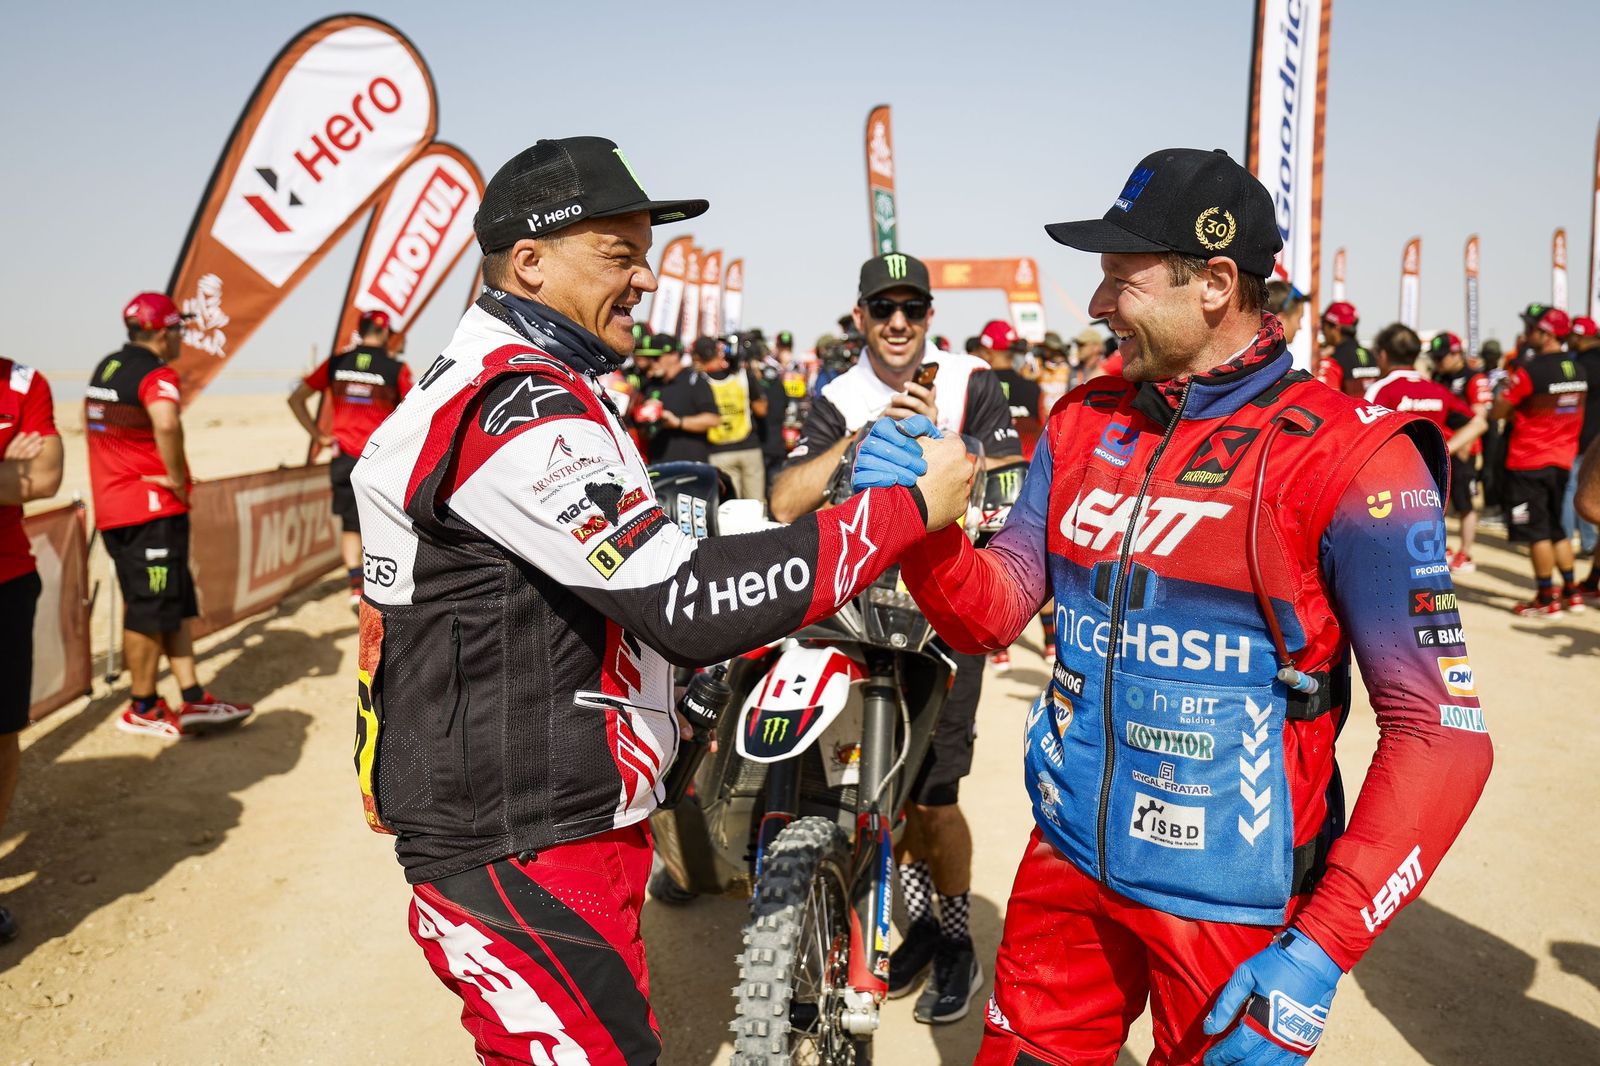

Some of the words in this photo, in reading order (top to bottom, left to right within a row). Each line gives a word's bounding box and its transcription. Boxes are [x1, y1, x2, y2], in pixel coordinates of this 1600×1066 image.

[294, 75, 403, 183] Hero
[545, 203, 583, 226] Hero
[1204, 218, 1228, 239] 30
[377, 176, 464, 309] MOTUL
[596, 549, 616, 571] 8
[708, 556, 811, 616] Hero
[1180, 716, 1217, 727] holding
[1151, 816, 1200, 840] ISBD
[881, 856, 893, 925] MICHELIN
[1359, 844, 1424, 933] LEATT
